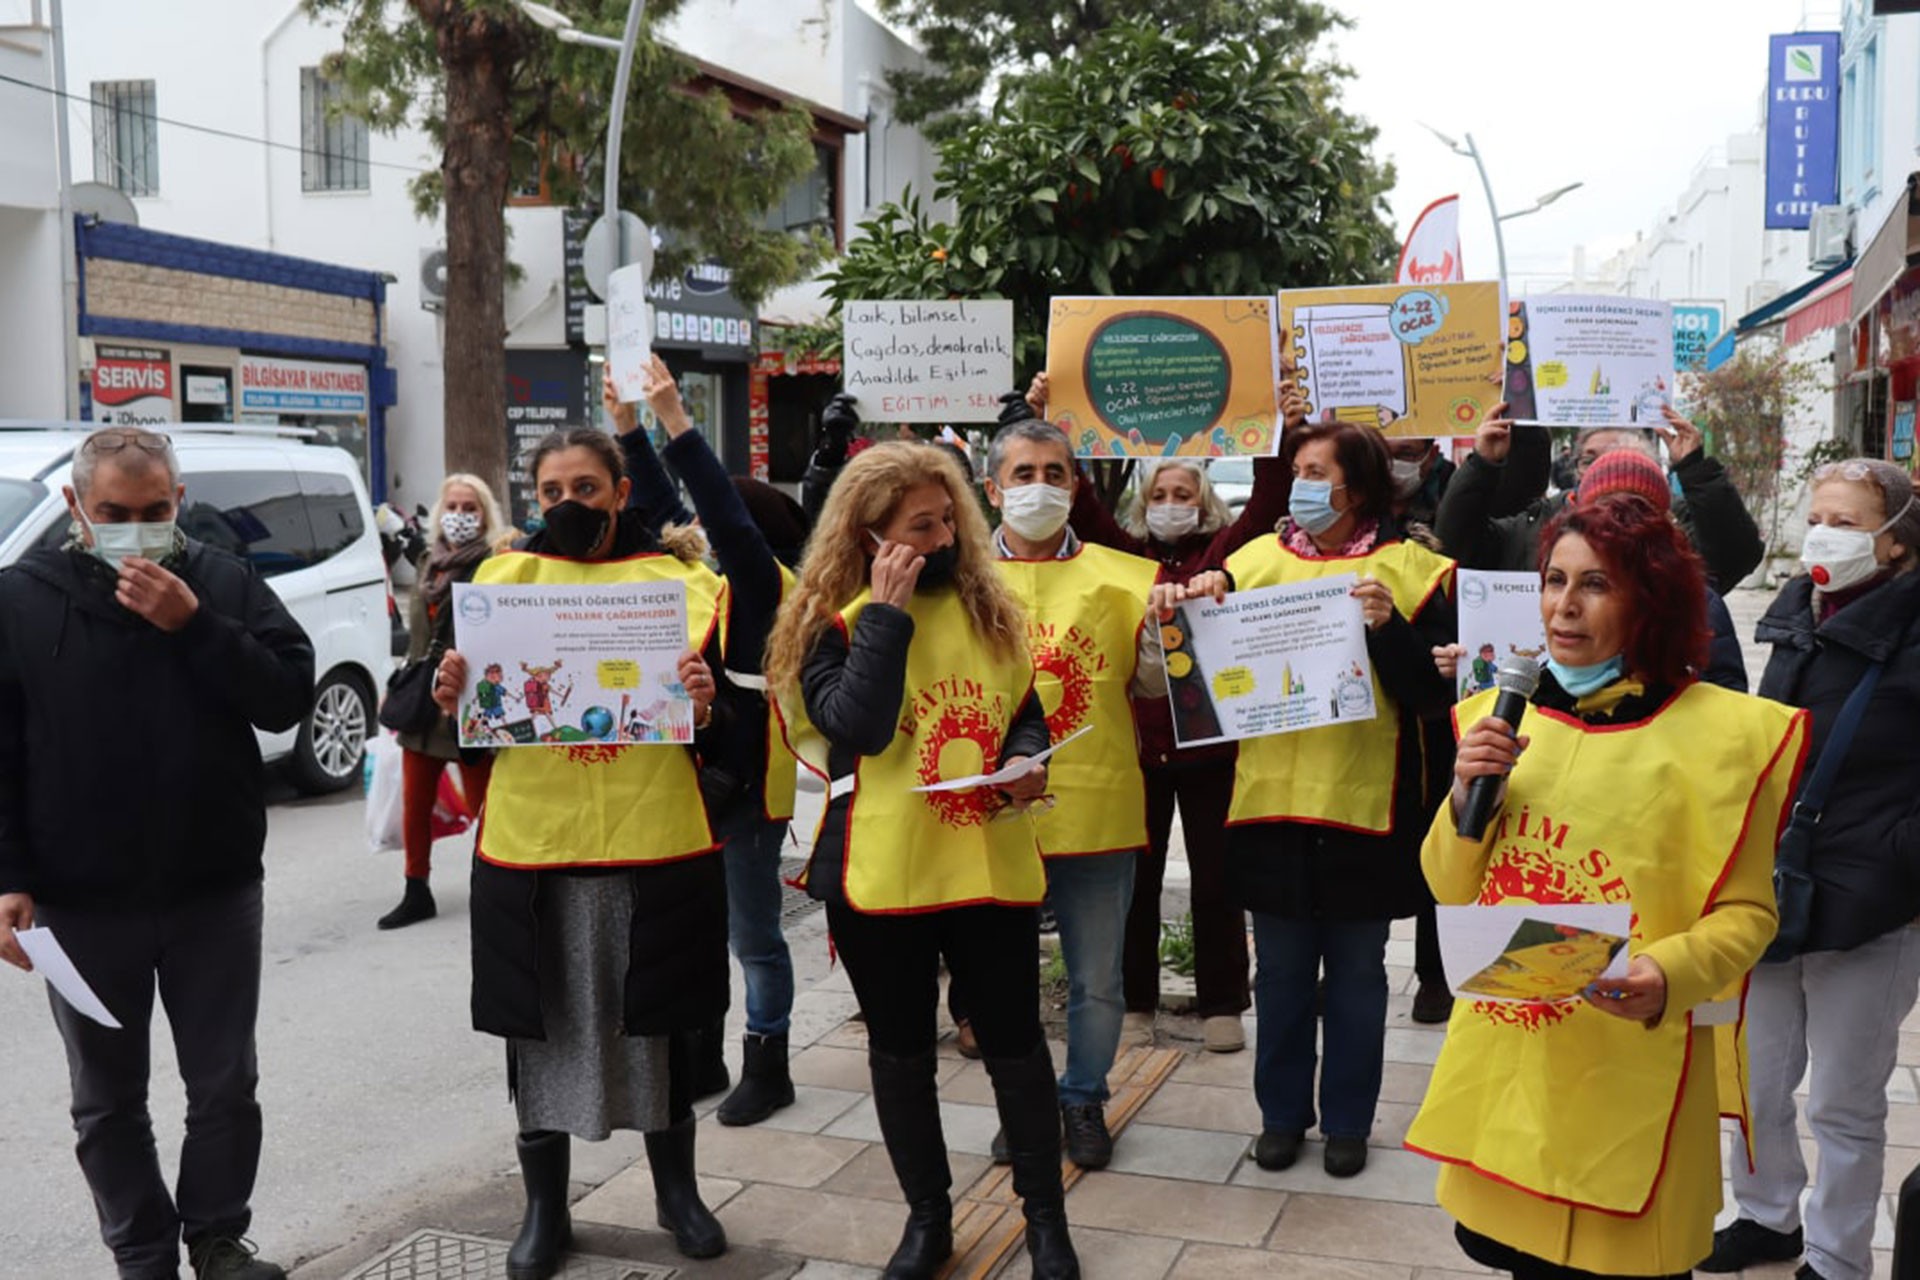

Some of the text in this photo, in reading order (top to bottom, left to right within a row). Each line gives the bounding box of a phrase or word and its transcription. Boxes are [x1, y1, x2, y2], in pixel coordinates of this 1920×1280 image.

[1776, 86, 1829, 101] DURU
[1400, 314, 1436, 333] OCAK
[97, 362, 166, 390] SERVİS
[242, 362, 365, 392] BİLGİSAYAR HASTANESİ
[1106, 395, 1141, 413] OCAK
[525, 406, 568, 420] TELEFONU
[1493, 583, 1535, 593] SEÇMELİ
[497, 595, 545, 608] SEÇMELİ
[549, 595, 583, 607] DERSİ
[585, 593, 638, 607] ÖĞRENCİ
